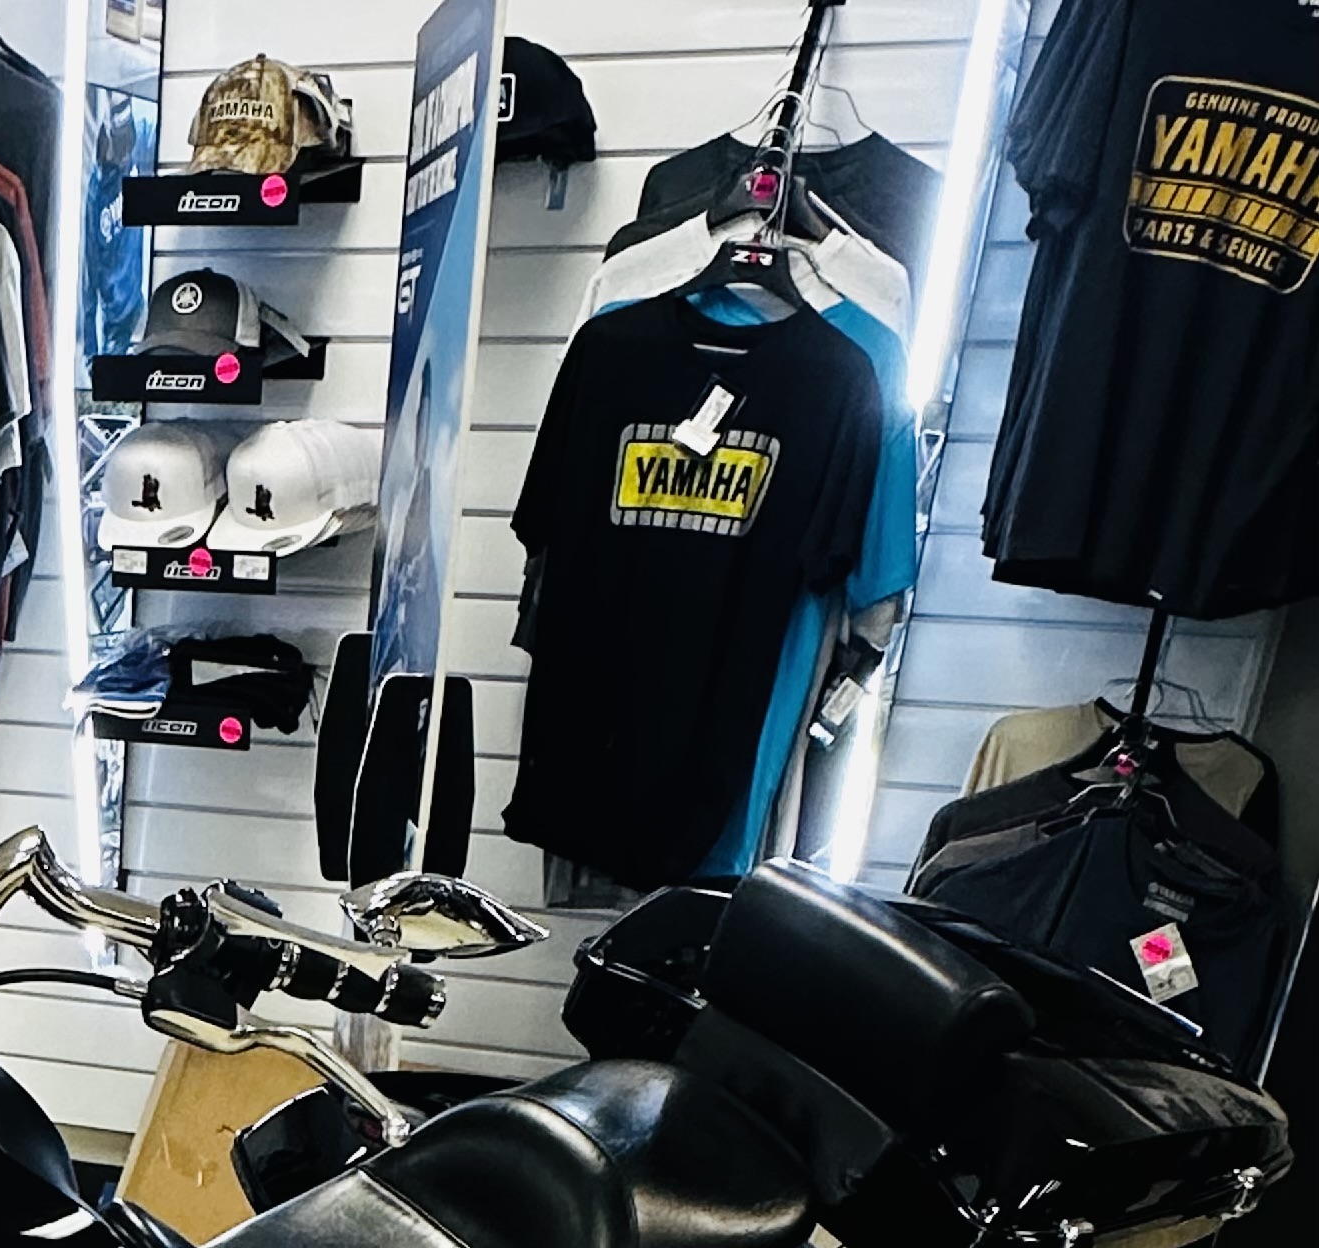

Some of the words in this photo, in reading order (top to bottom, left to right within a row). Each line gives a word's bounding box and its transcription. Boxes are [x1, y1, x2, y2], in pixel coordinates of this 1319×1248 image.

[208, 100, 276, 121] YAMAHA
[1185, 91, 1261, 118] GENUINE
[1133, 217, 1196, 247] PARTS
[635, 456, 754, 506] YAMAHA
